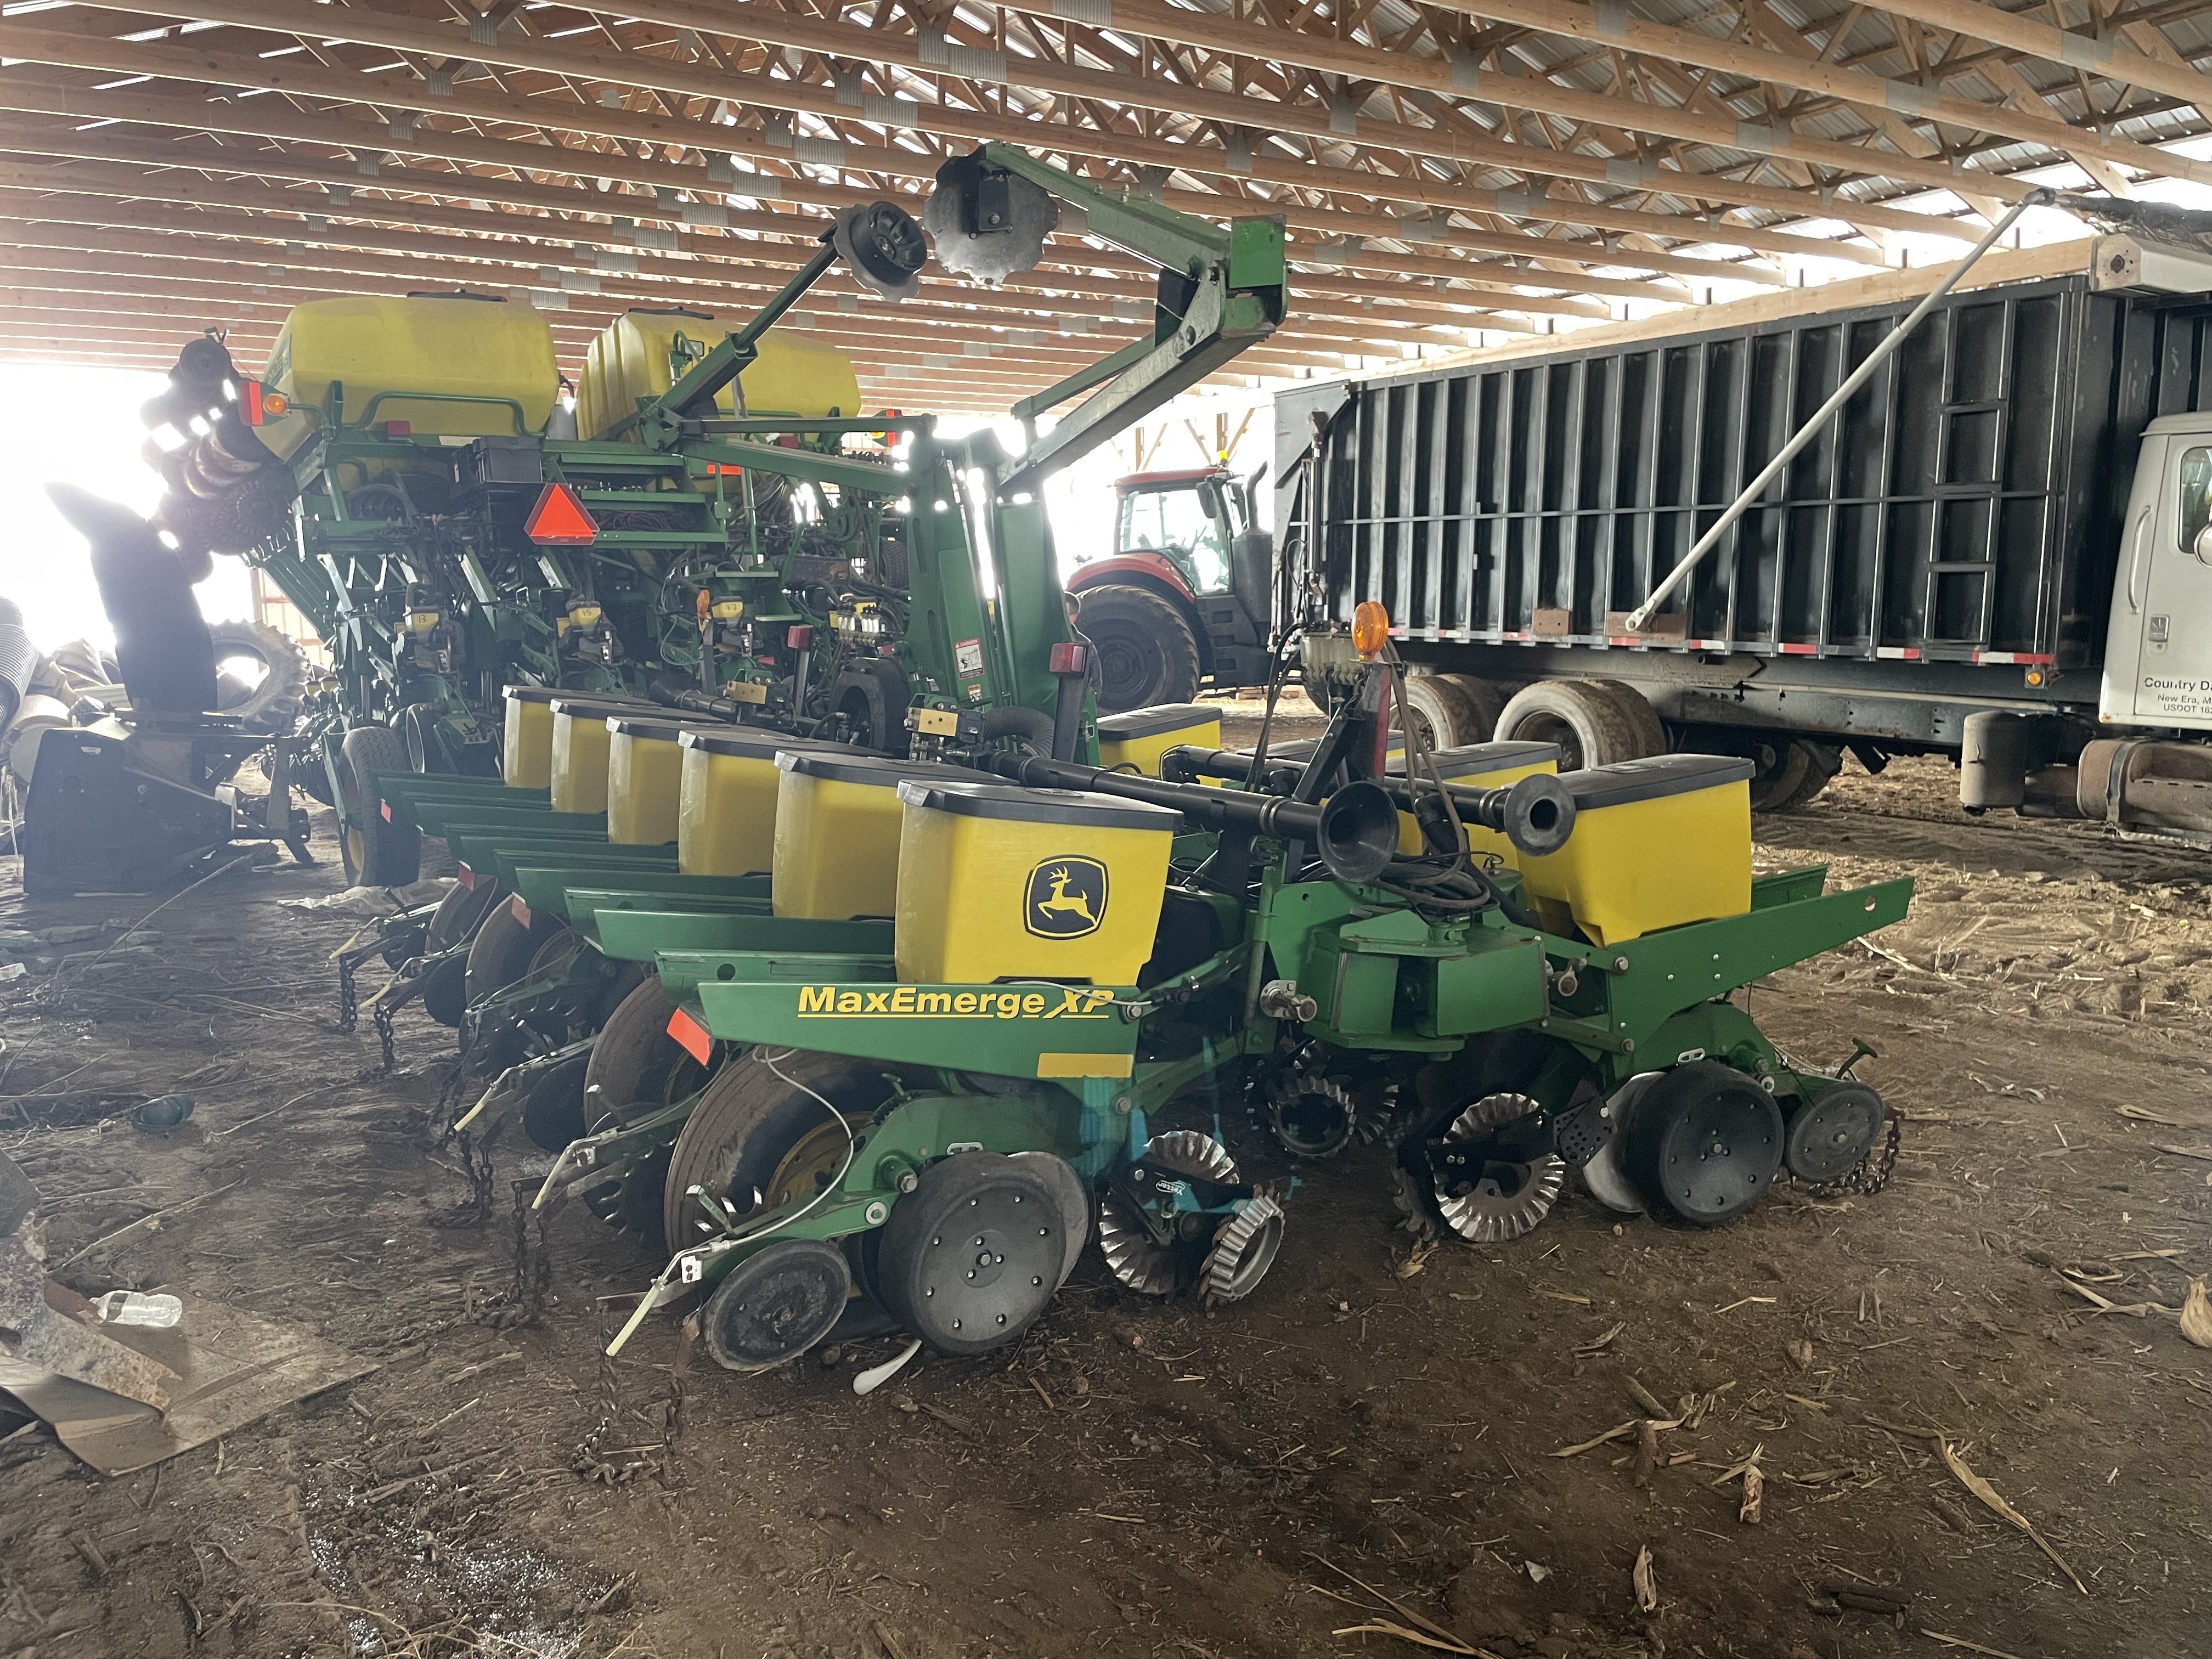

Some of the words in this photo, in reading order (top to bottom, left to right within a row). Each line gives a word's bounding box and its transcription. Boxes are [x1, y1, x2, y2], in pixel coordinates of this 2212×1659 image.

[419, 614, 426, 623] 13
[2158, 694, 2178, 702] New
[2181, 695, 2199, 705] Era,
[2164, 703, 2197, 713] USDOT
[798, 986, 1045, 1019] MaxEmerge
[1042, 989, 1114, 1019] XP
[1158, 1182, 1183, 1196] Yetter
